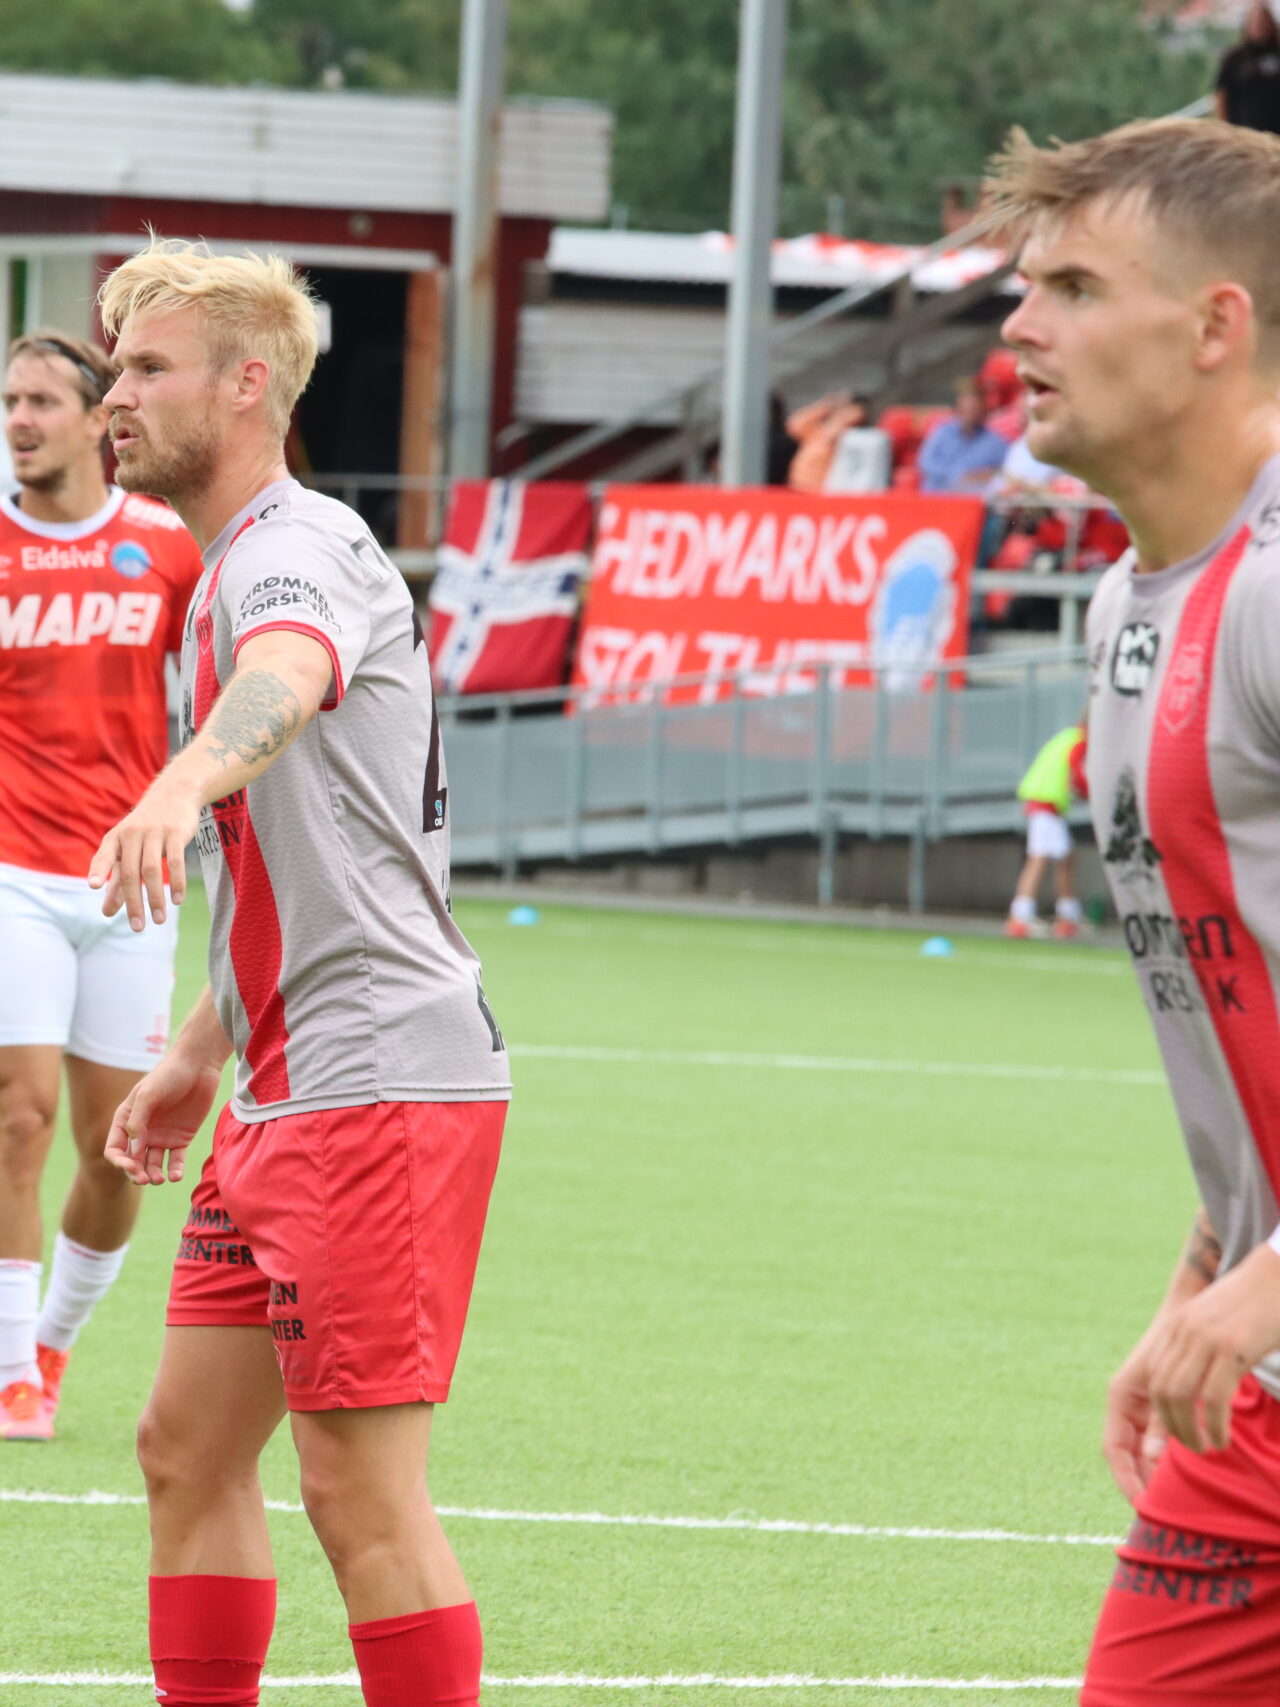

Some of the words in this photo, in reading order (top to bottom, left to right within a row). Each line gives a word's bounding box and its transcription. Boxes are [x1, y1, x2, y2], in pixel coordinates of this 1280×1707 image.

[21, 544, 105, 571] Eidsiva
[596, 503, 887, 606] HEDMARKS
[240, 576, 335, 621] TRØMMEN
